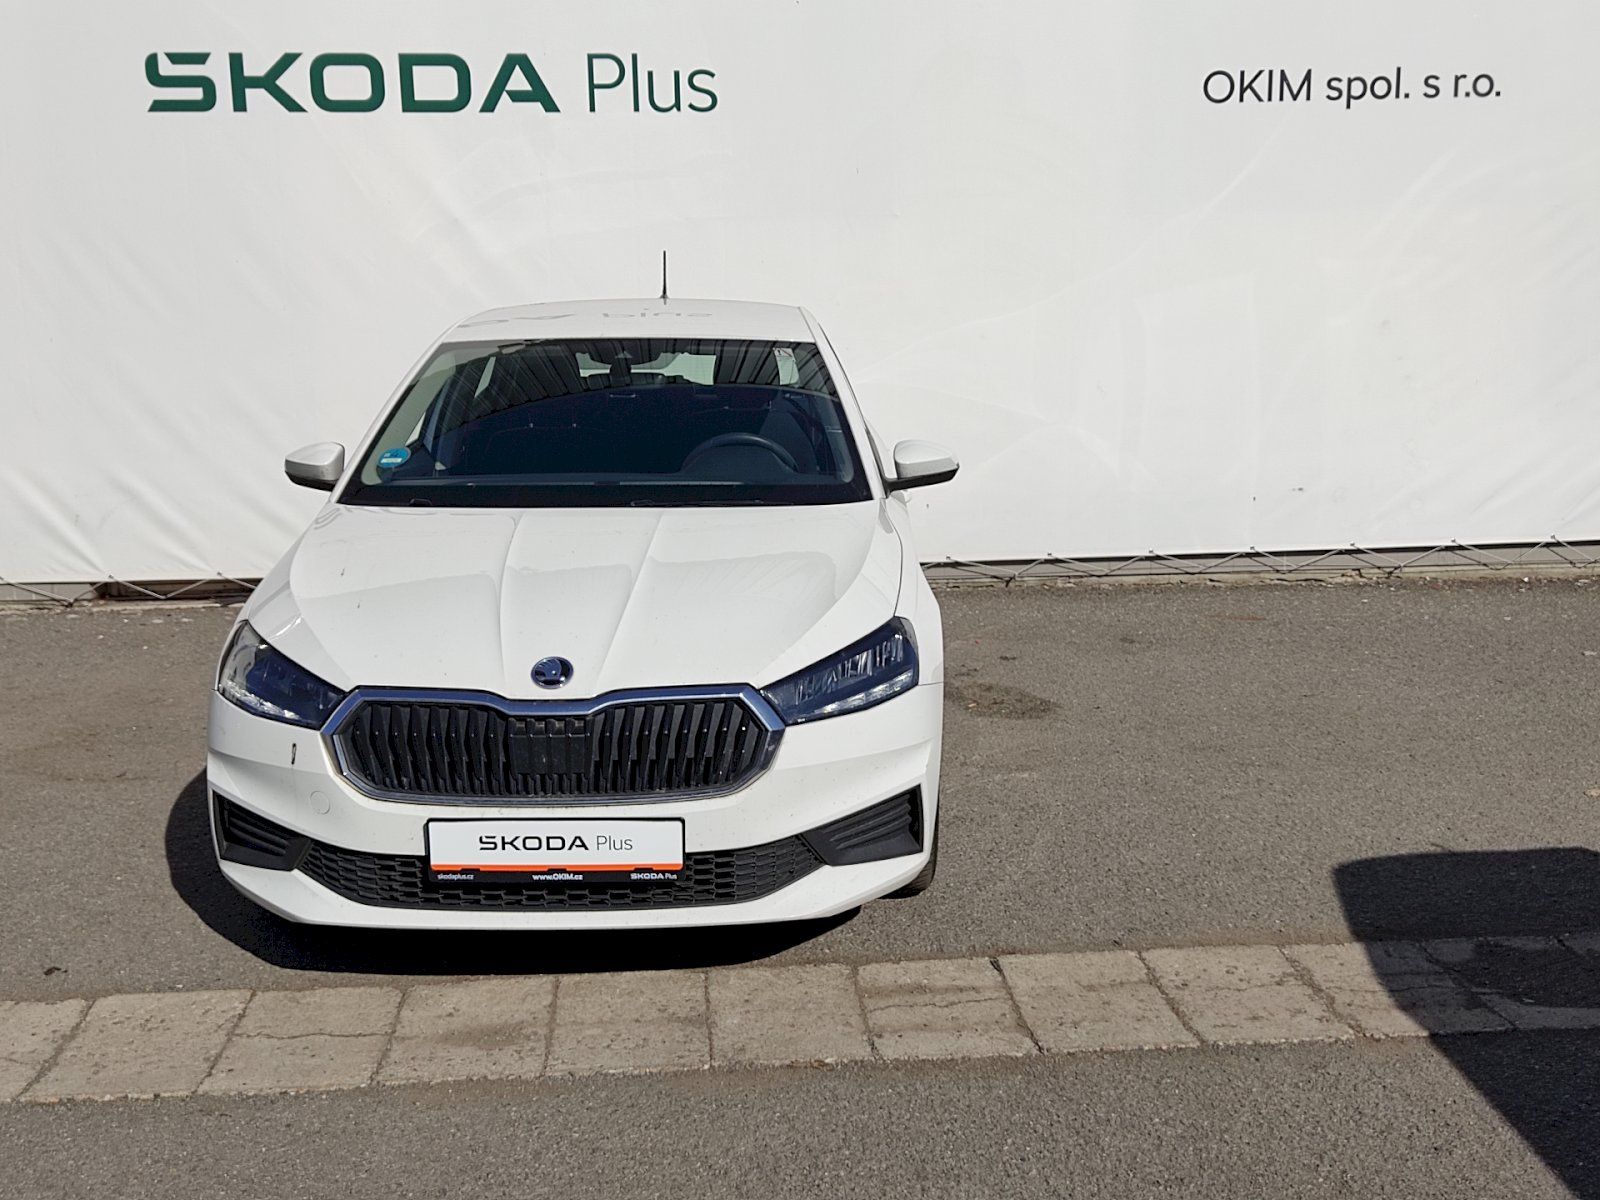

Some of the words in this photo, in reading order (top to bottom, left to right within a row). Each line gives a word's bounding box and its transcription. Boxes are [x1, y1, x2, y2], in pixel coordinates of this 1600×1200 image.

[587, 52, 718, 113] Plus
[1203, 68, 1312, 104] OKIM
[1325, 66, 1410, 110] spol.
[1422, 73, 1441, 99] s
[1453, 72, 1501, 98] r.o.
[596, 835, 634, 851] Plus
[437, 873, 475, 881] skodaplus.cz
[532, 872, 584, 881] www.OKIM.cz
[664, 872, 678, 880] Plus
